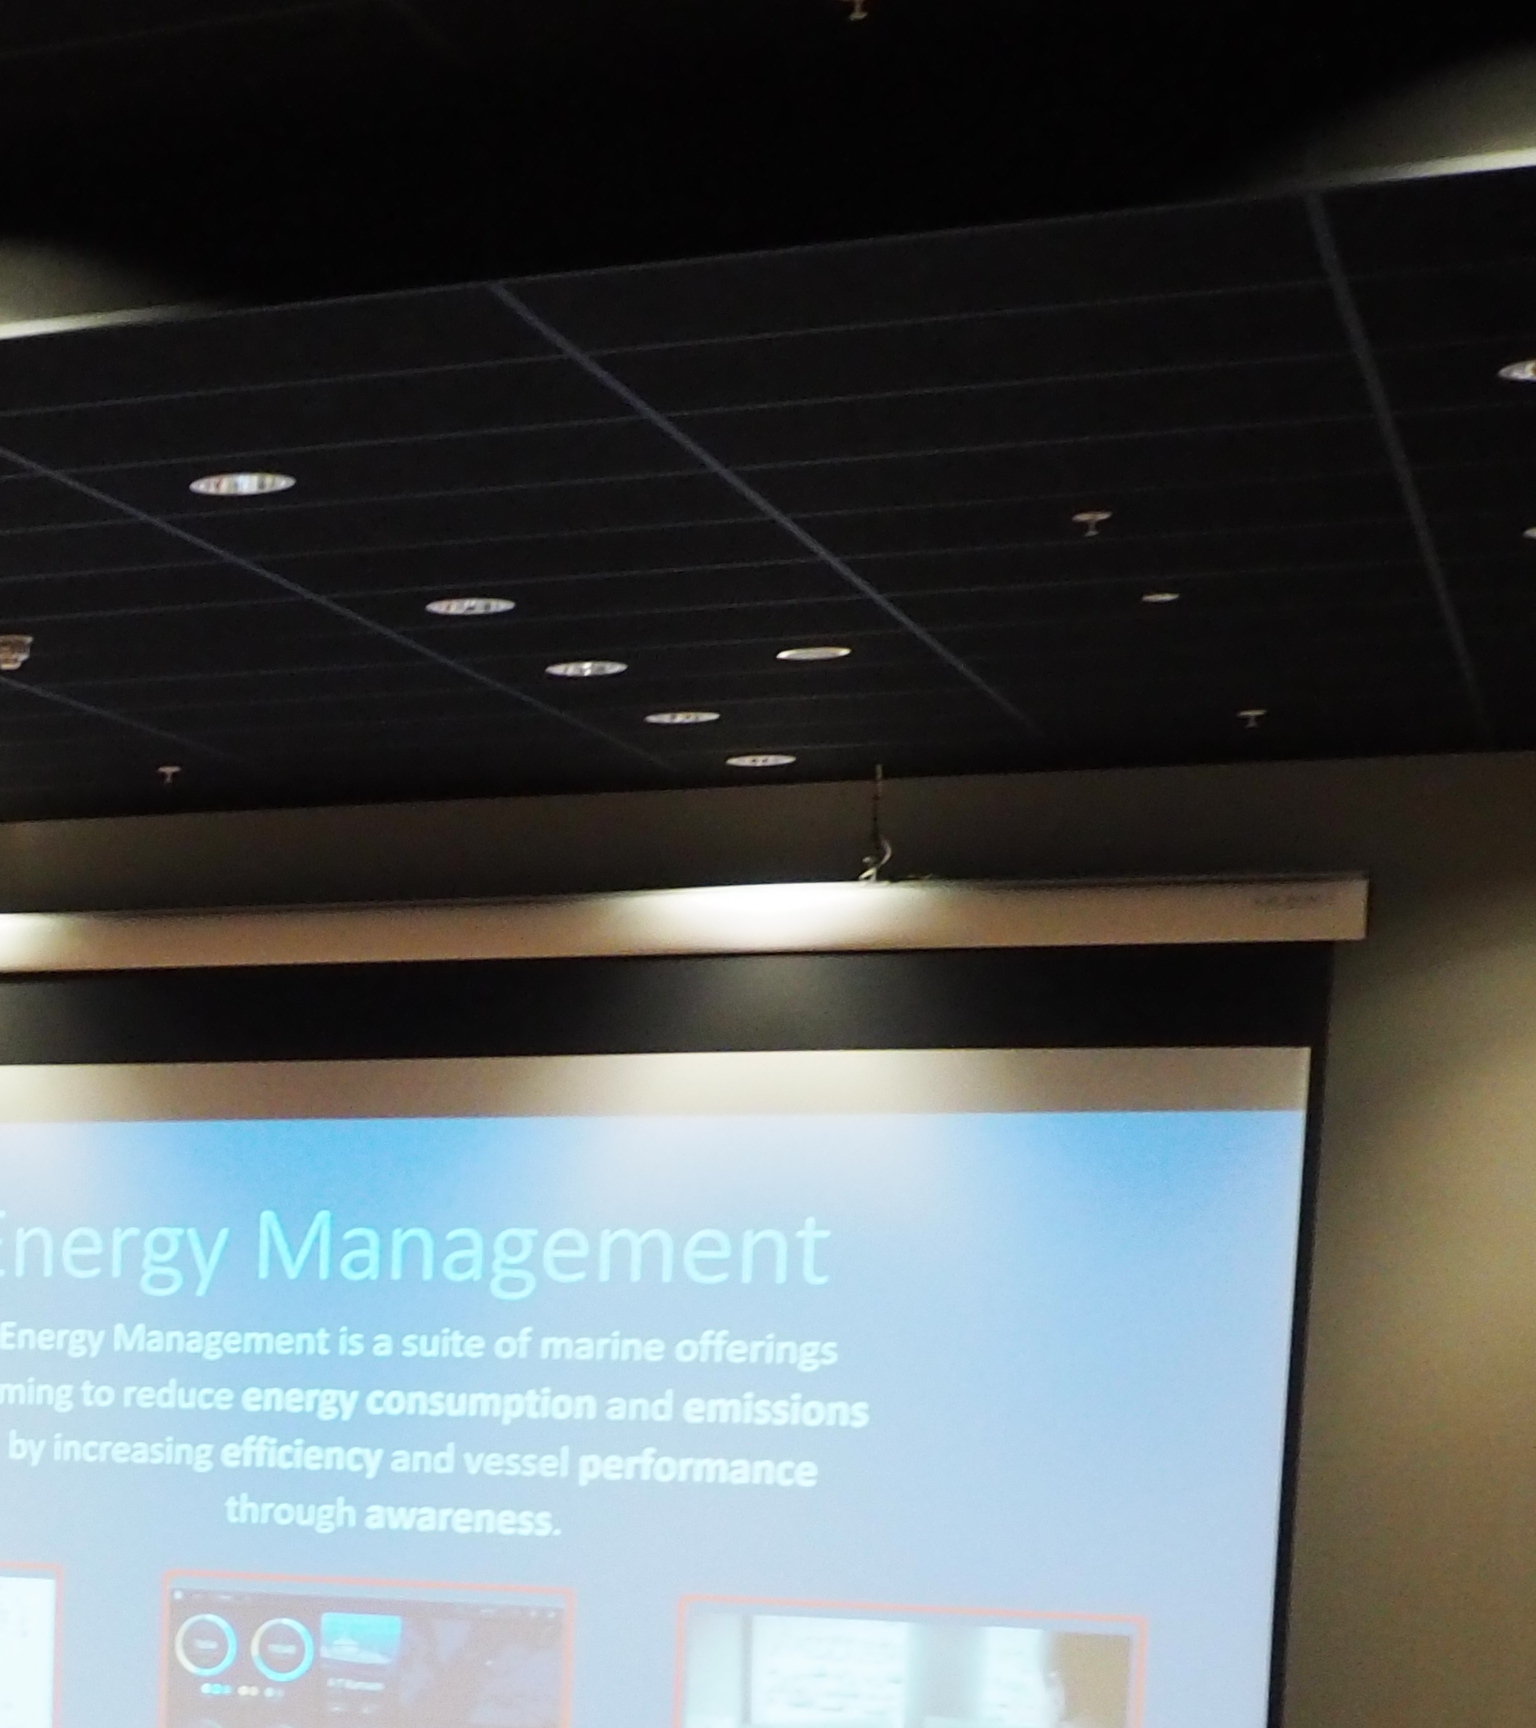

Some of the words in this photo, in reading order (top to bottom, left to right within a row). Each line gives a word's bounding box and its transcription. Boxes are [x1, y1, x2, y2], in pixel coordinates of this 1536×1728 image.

[257, 1209, 832, 1301] Management
[0, 1321, 106, 1359] Energy
[113, 1323, 331, 1361] Management
[338, 1326, 365, 1357] is
[372, 1333, 394, 1357] a
[401, 1327, 486, 1359] suite
[494, 1327, 534, 1359] of
[539, 1331, 666, 1362] marine
[675, 1329, 840, 1373] offerings
[81, 1379, 116, 1408] to
[123, 1378, 235, 1411] reduce
[241, 1386, 359, 1421] energy
[365, 1387, 597, 1426] consumption
[605, 1389, 674, 1422] and
[682, 1391, 870, 1429] emissions
[9, 1429, 46, 1468] by
[53, 1433, 215, 1473] increasing
[221, 1435, 384, 1480] efficiency
[390, 1442, 456, 1475] and
[463, 1445, 570, 1478] vessel
[578, 1446, 819, 1488] performance
[225, 1492, 357, 1534] through
[364, 1503, 562, 1537] awareness.
